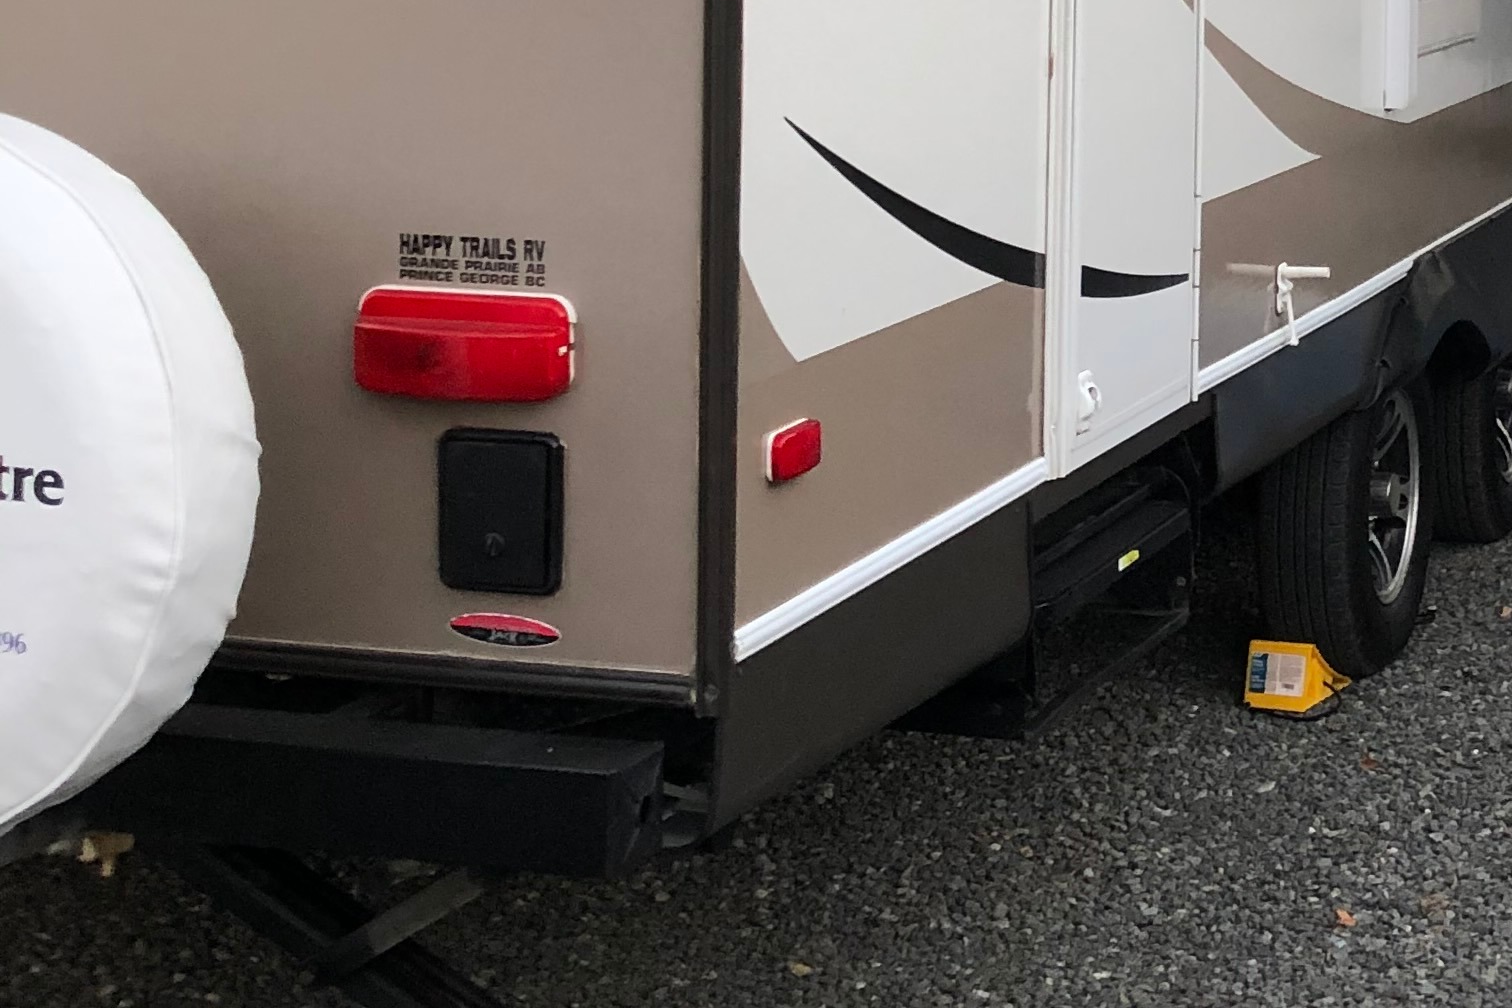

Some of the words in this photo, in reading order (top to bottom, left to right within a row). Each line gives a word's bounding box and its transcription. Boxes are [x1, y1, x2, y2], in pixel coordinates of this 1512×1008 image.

[399, 233, 453, 258] HAPPY
[460, 236, 517, 261] TRAILS
[523, 239, 546, 262] RV
[399, 256, 459, 271] GRANDE
[464, 260, 520, 274] PRAIRIE
[526, 263, 546, 275] AB
[399, 269, 453, 283] PRINCE
[459, 272, 519, 286] GEORGE
[525, 275, 546, 288] BC
